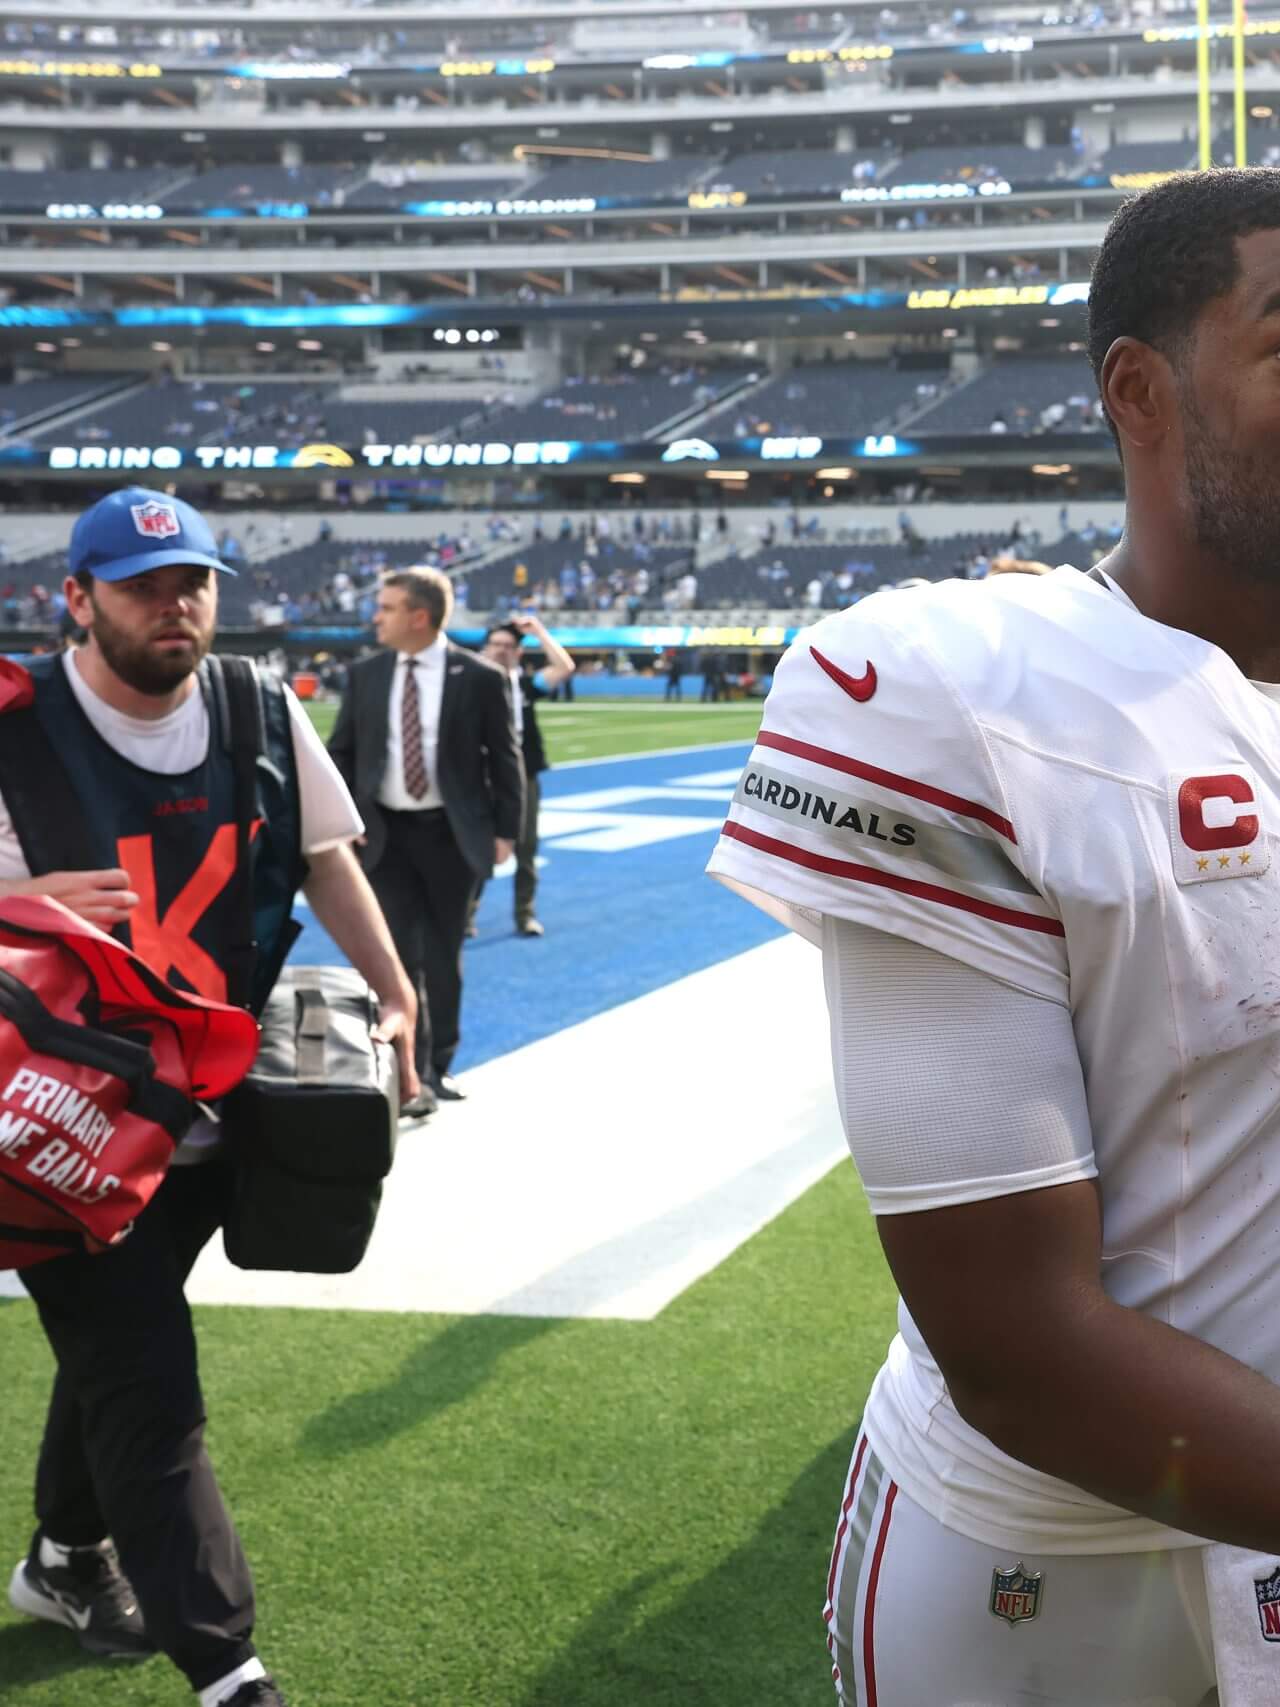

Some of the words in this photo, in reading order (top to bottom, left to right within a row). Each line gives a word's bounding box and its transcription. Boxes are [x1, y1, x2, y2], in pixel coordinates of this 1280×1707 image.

[49, 446, 182, 469] BRING
[196, 445, 279, 469] THE
[362, 441, 573, 467] THUNDER
[744, 772, 916, 846] CARDINALS
[1178, 774, 1260, 852] C
[2, 1066, 116, 1158] PRIMARY
[26, 1137, 121, 1204] BALLS
[996, 1592, 1032, 1617] NFL
